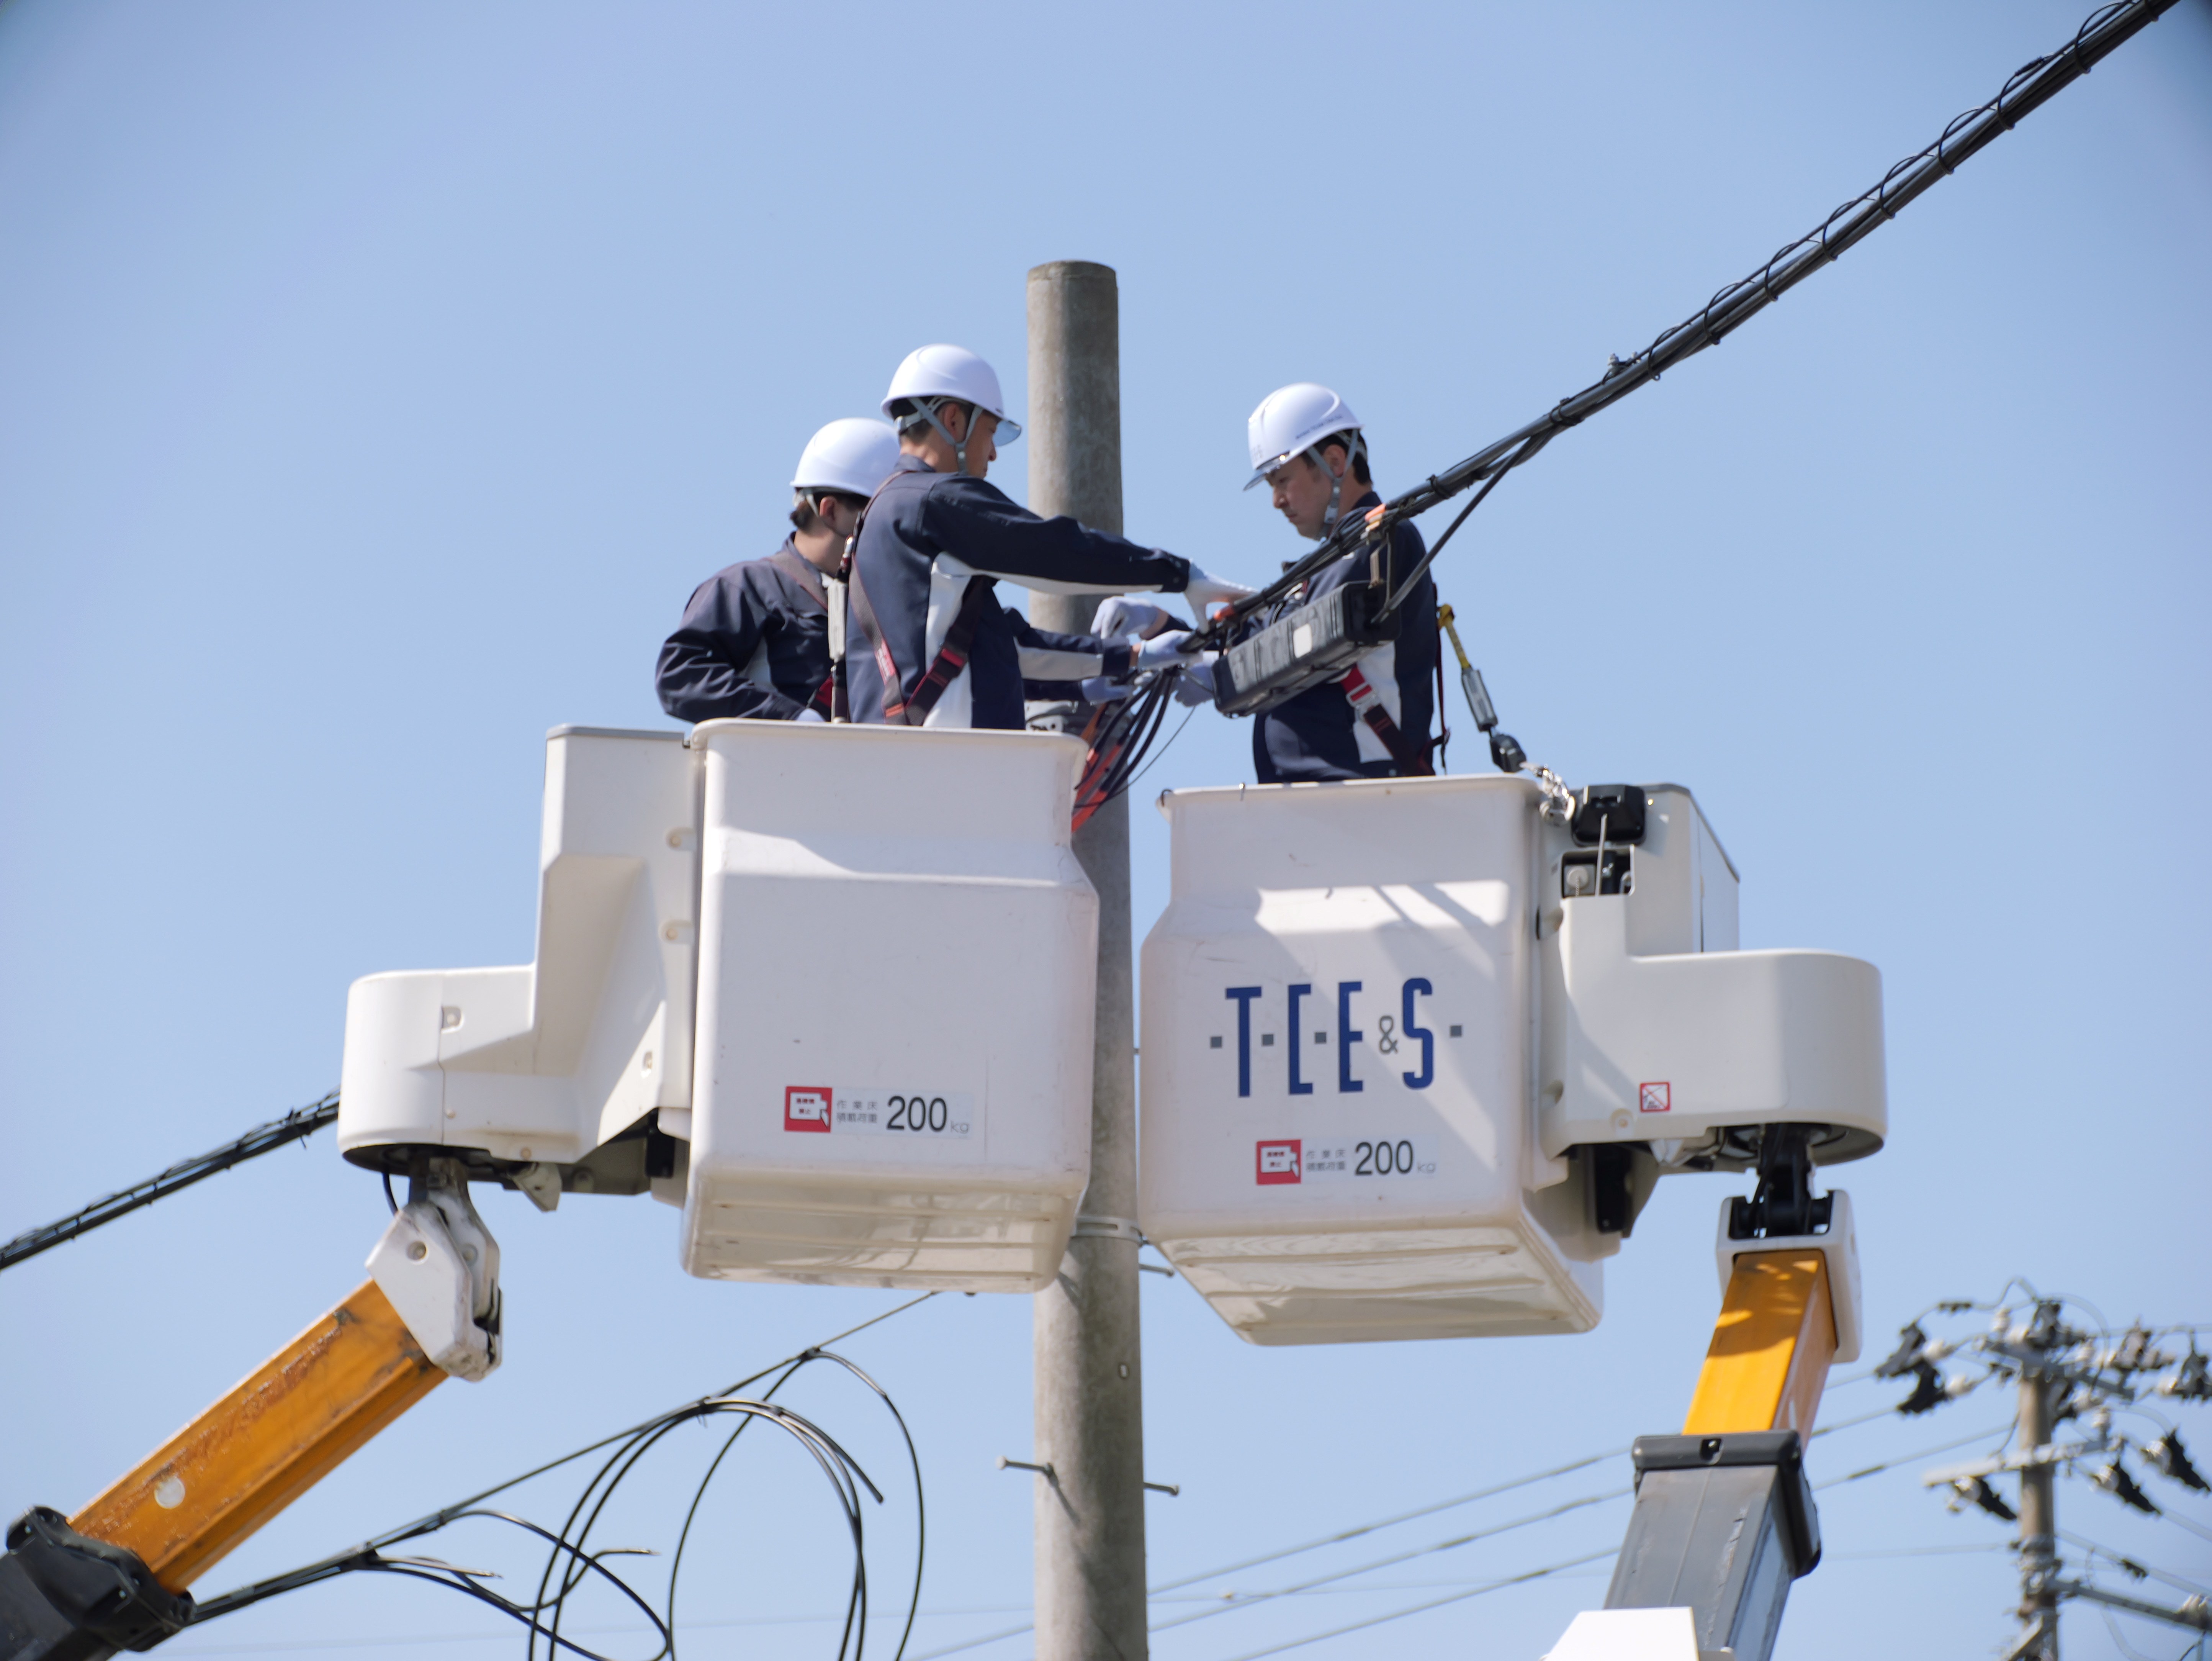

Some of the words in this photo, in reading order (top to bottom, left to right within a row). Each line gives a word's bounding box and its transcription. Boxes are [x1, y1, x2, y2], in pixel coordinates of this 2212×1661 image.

[887, 1096, 947, 1132] 200
[950, 1120, 969, 1134] kg
[1355, 1140, 1414, 1176] 200
